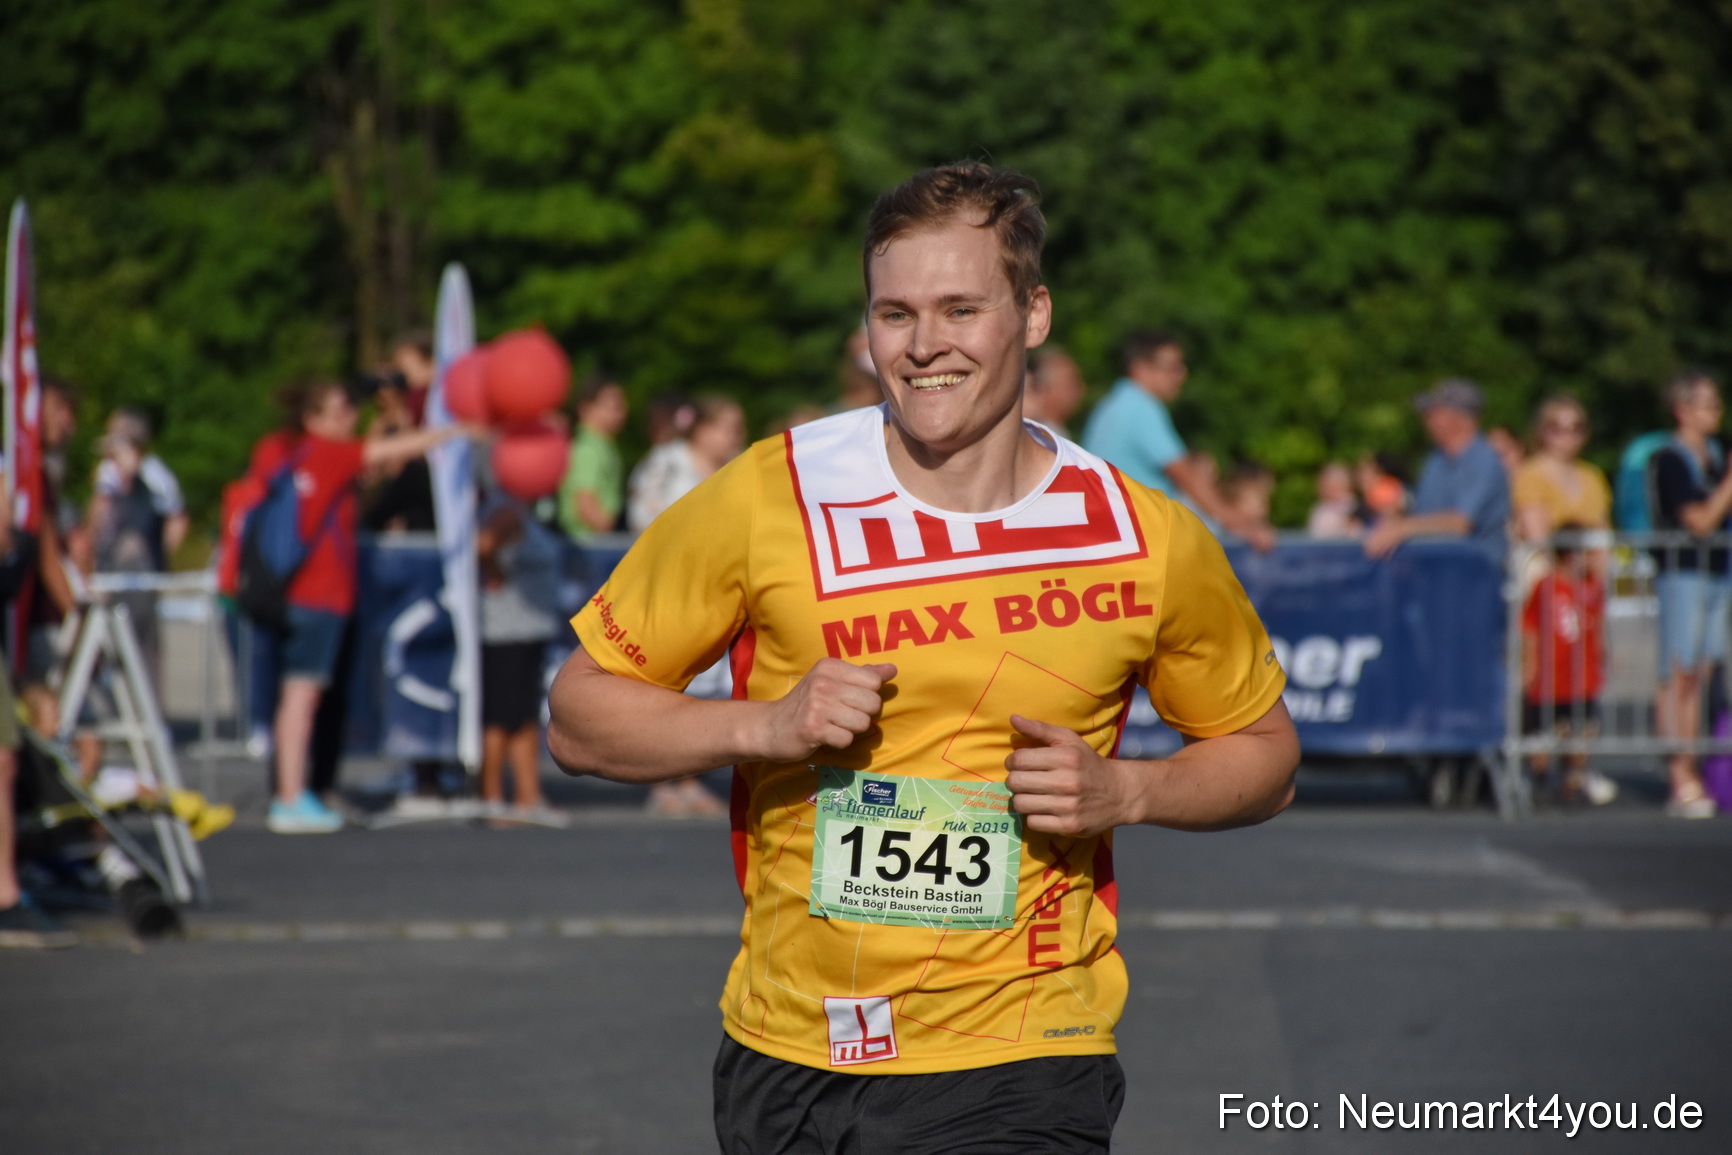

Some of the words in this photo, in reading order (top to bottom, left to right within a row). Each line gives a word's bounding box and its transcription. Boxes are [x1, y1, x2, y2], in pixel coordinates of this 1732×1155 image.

[821, 601, 976, 660] MAX
[994, 578, 1154, 634] BÖGL
[845, 814, 880, 823] neumarkt
[847, 799, 927, 821] firmenlauf
[972, 822, 1009, 834] 2019
[841, 825, 991, 888] 1543
[843, 880, 919, 900] Beckstein
[924, 888, 982, 903] Bastian
[839, 895, 859, 907] Max
[863, 897, 887, 911] Bögl
[890, 901, 948, 914] Bauservice
[950, 905, 983, 915] GmbH
